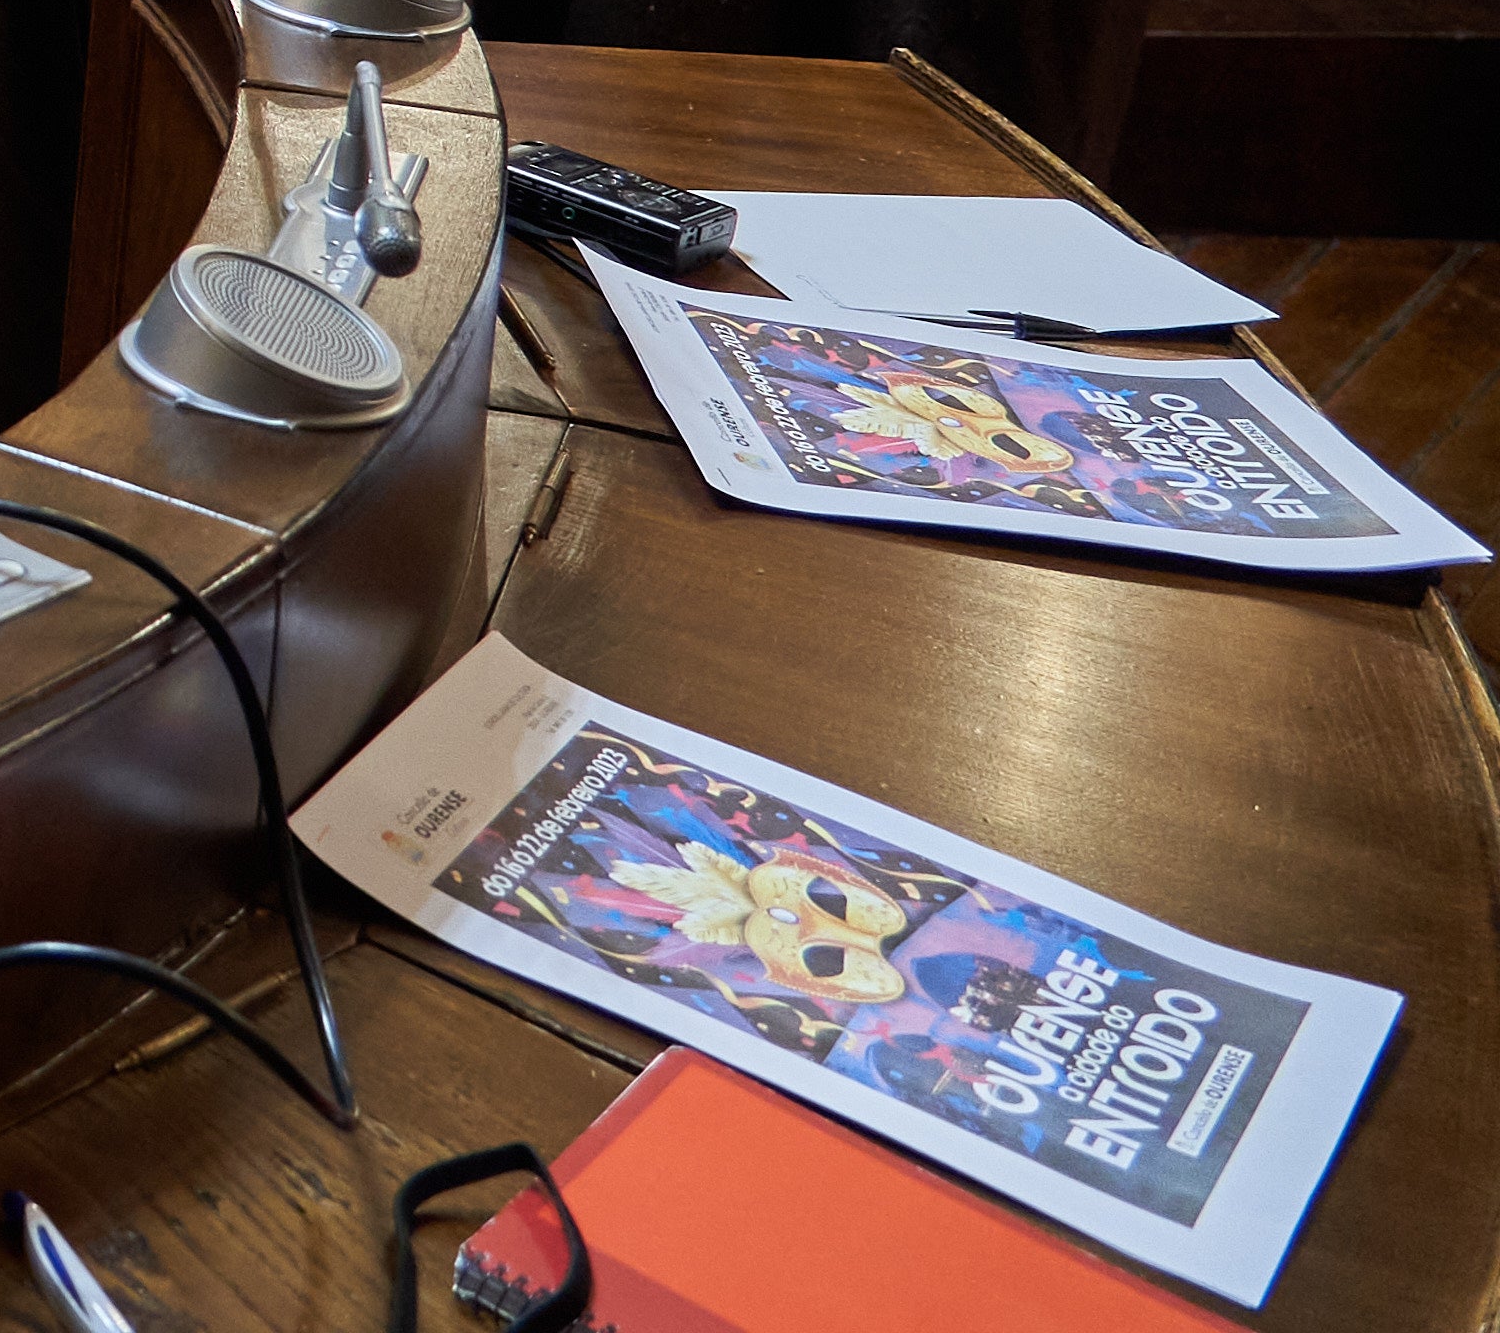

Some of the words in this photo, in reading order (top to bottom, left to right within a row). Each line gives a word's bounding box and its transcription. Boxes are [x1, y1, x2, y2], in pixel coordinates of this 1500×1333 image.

[710, 323, 746, 352] 2023
[765, 398, 789, 414] de
[773, 417, 802, 431] 22
[1150, 416, 1178, 432] do
[790, 440, 818, 453] 16
[1078, 389, 1232, 511] OURENSE
[1150, 393, 1319, 519] ENTROIDO
[1169, 434, 1225, 478] cidade
[805, 455, 831, 472] do
[1216, 480, 1237, 489] a
[586, 747, 628, 781] 2023
[414, 789, 468, 839] OURENSE
[532, 820, 564, 841] de
[516, 833, 550, 857] 22
[493, 857, 525, 879] 16
[481, 874, 513, 897] do
[1103, 1005, 1135, 1031] do
[972, 948, 1119, 1114] OURENSE
[1067, 1028, 1120, 1091] cidade
[1064, 988, 1217, 1170] ENTROIDO
[1058, 1084, 1087, 1103] a
